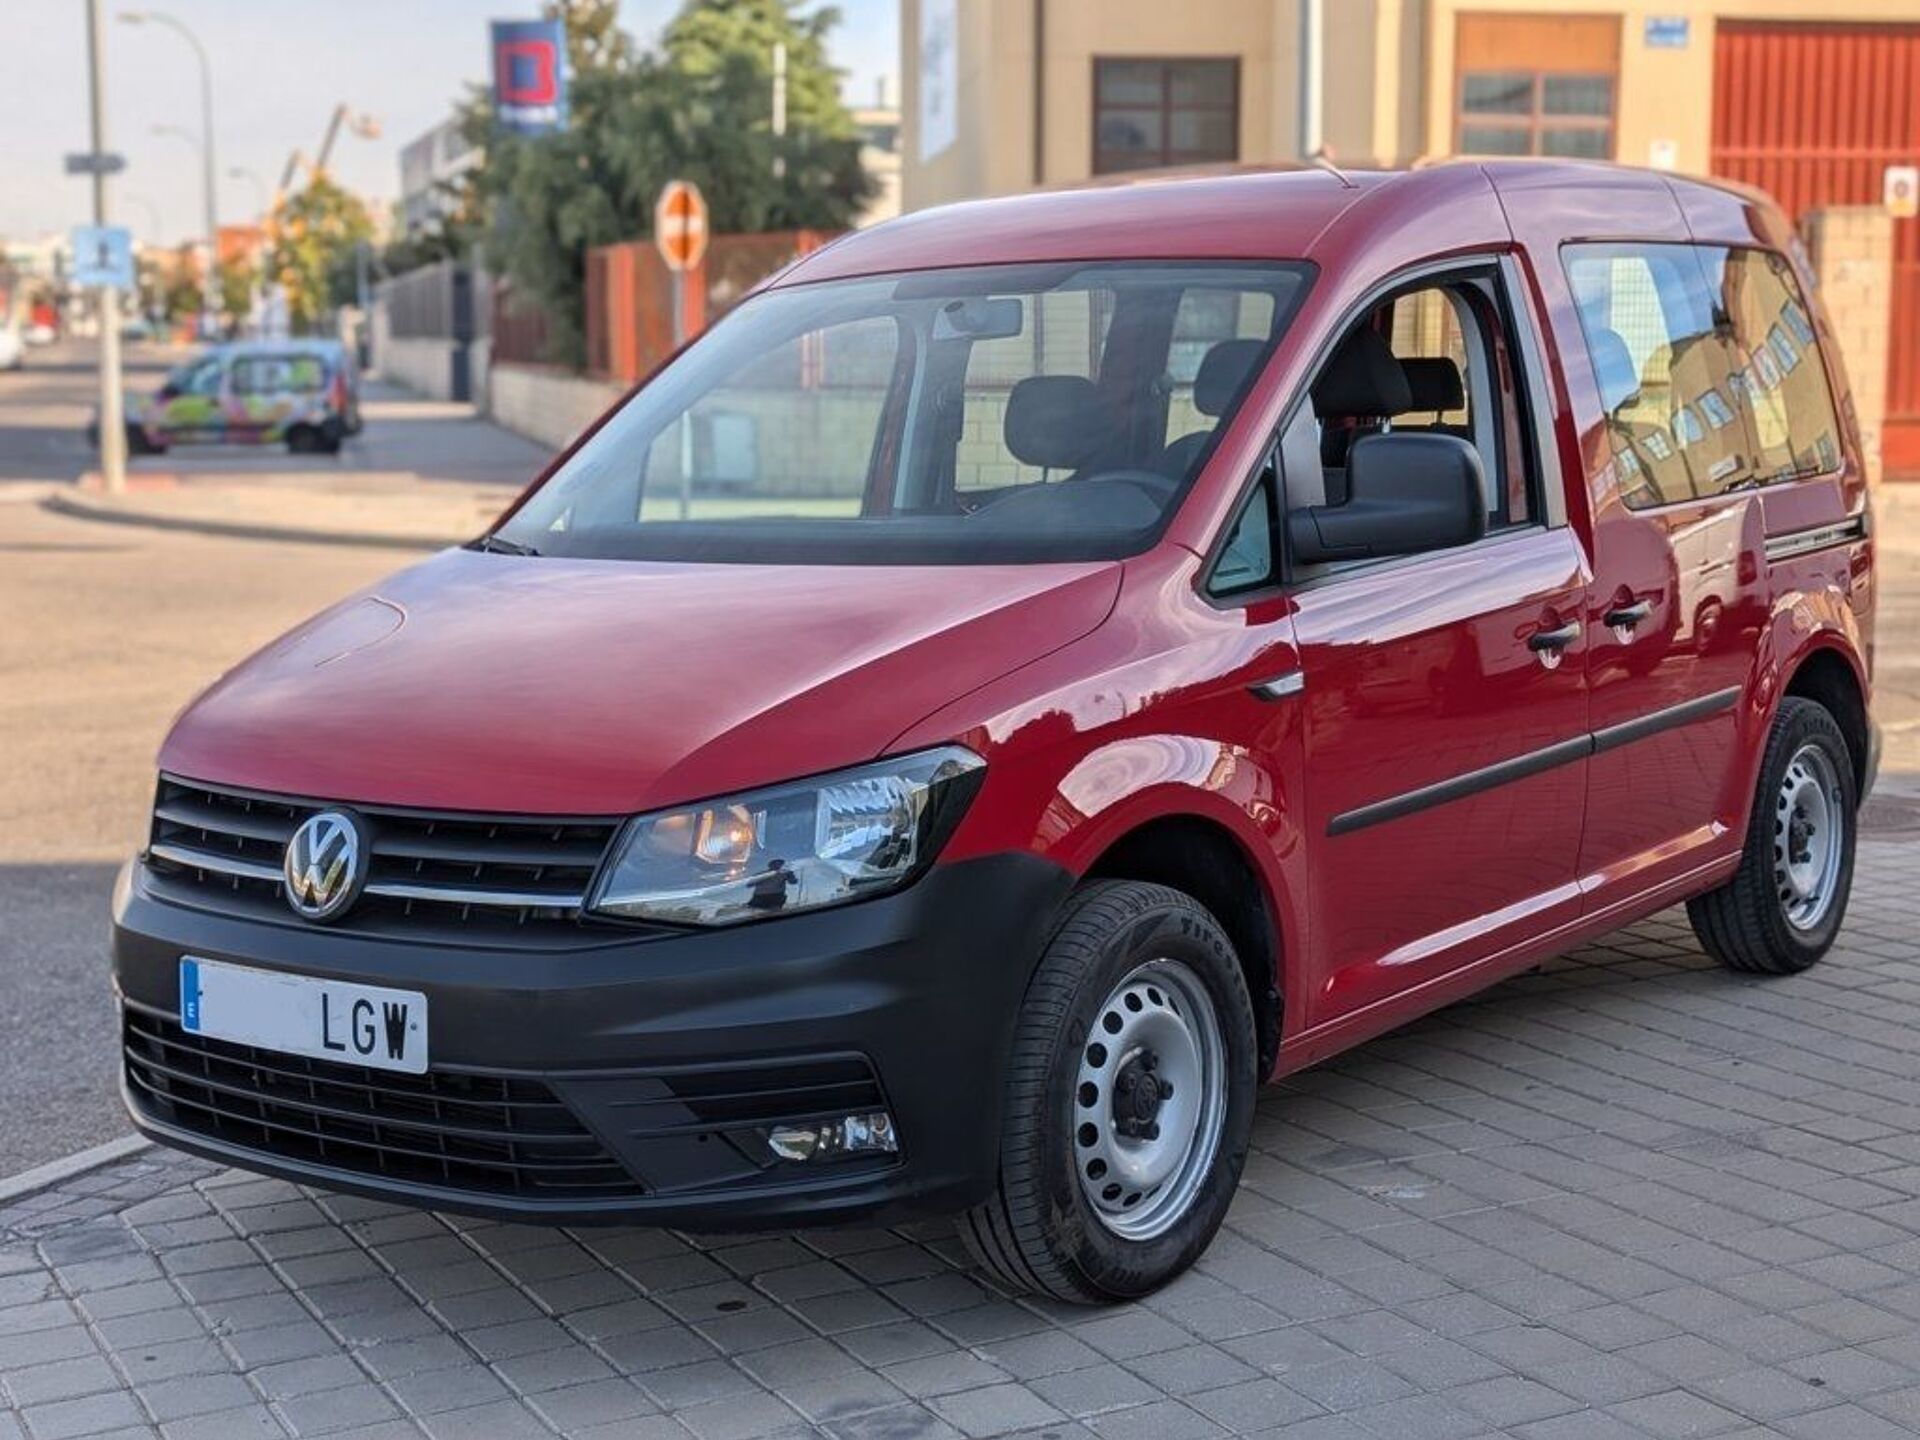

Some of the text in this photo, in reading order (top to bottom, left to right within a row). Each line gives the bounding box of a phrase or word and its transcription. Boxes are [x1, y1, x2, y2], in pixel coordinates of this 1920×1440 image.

[285, 813, 359, 915] VW
[186, 992, 407, 1060] E LGW
